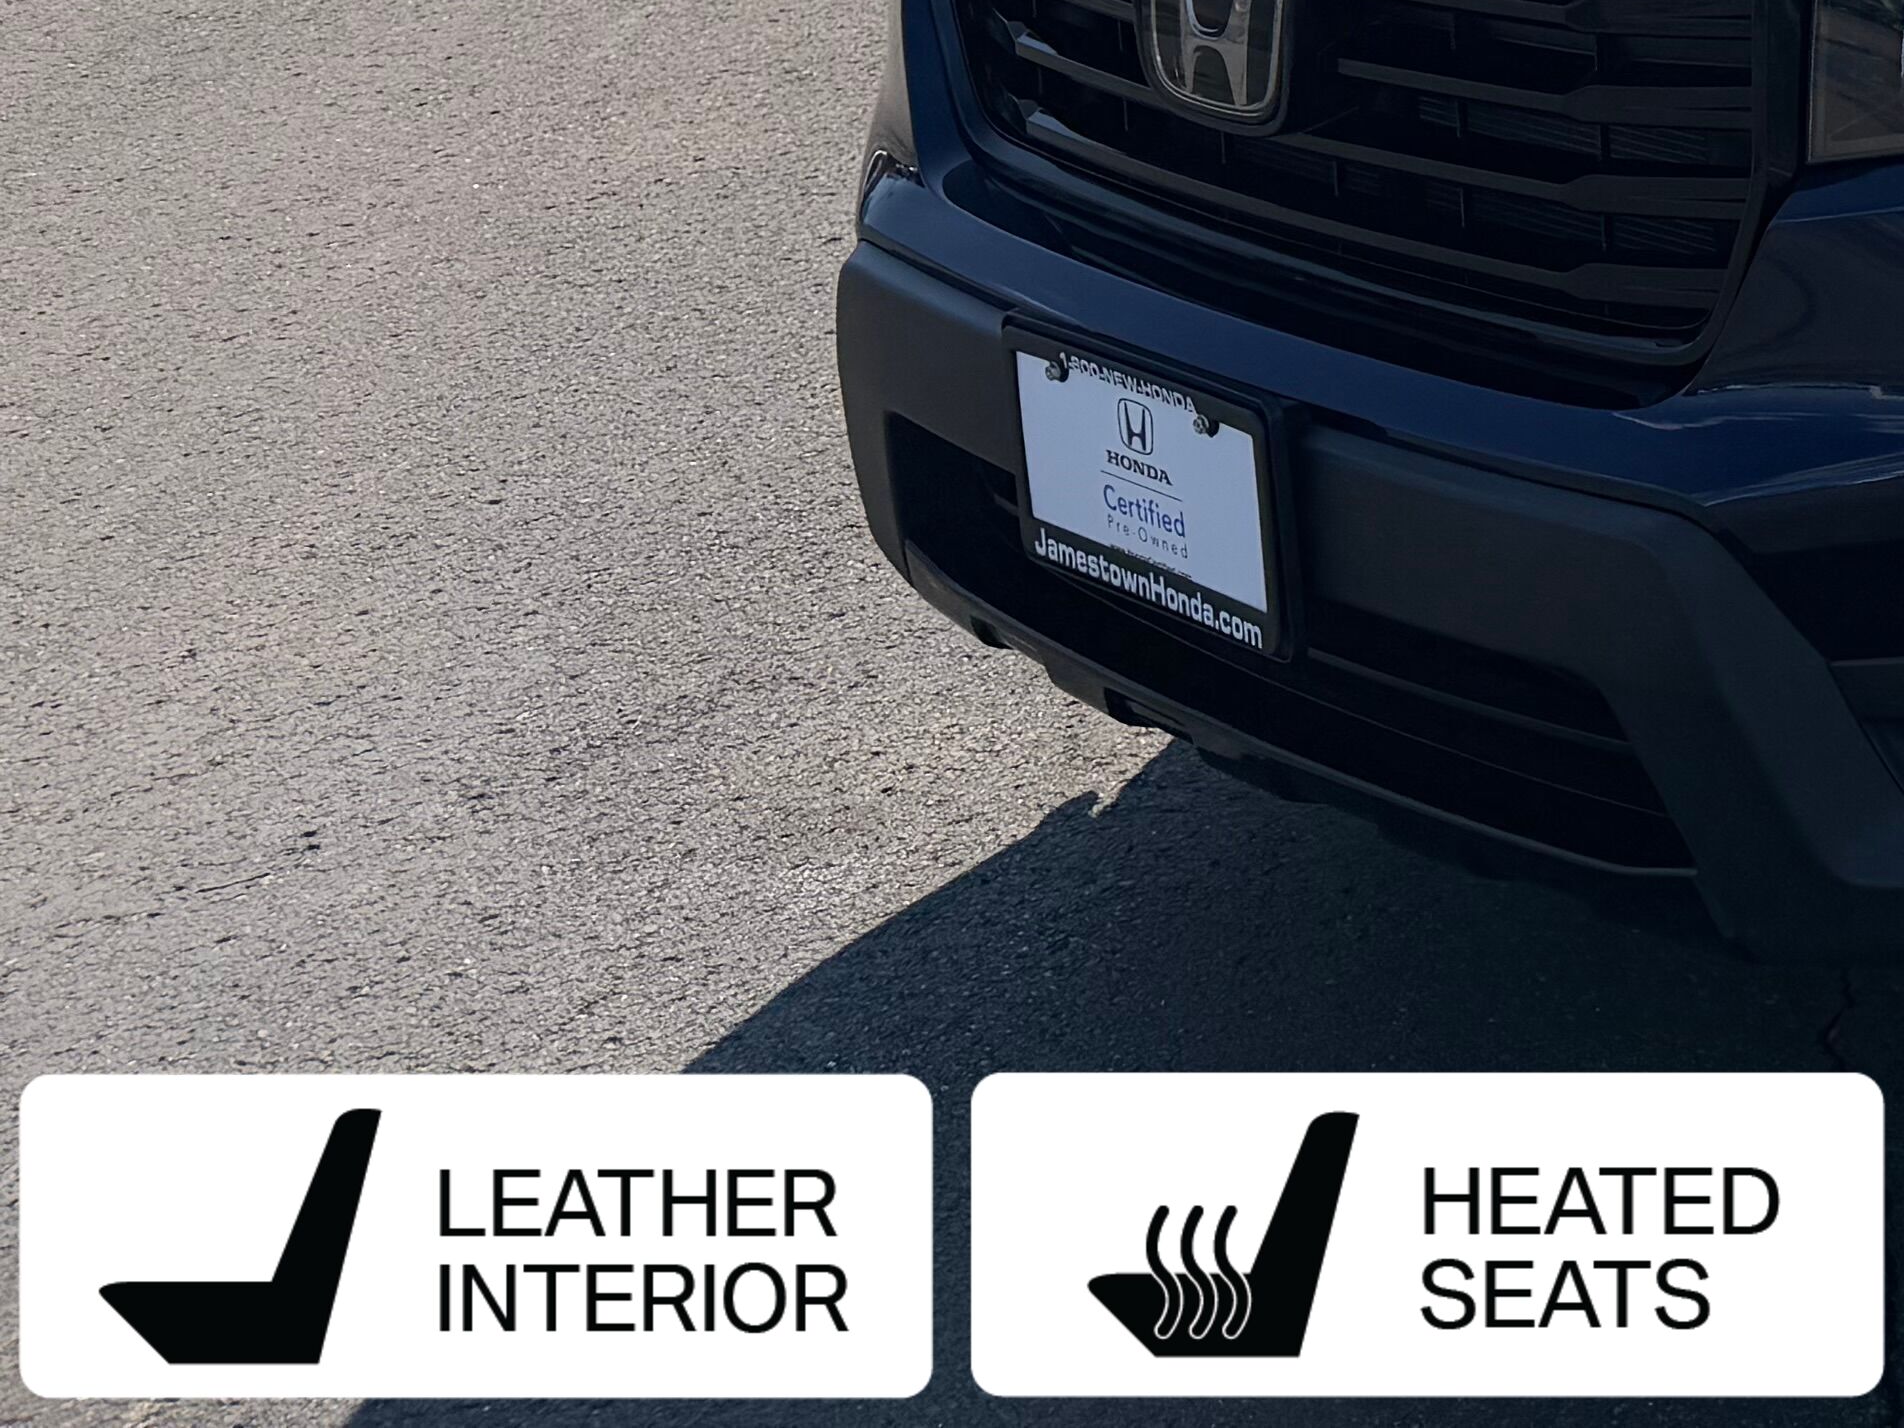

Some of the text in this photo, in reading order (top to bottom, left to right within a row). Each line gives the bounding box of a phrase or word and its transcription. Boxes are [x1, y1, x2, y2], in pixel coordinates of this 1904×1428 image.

[1105, 449, 1173, 487] HONDA
[1102, 484, 1186, 539] Certified
[1106, 513, 1189, 559] Pre-Owned
[1034, 527, 1263, 649] JamestownHonda.com
